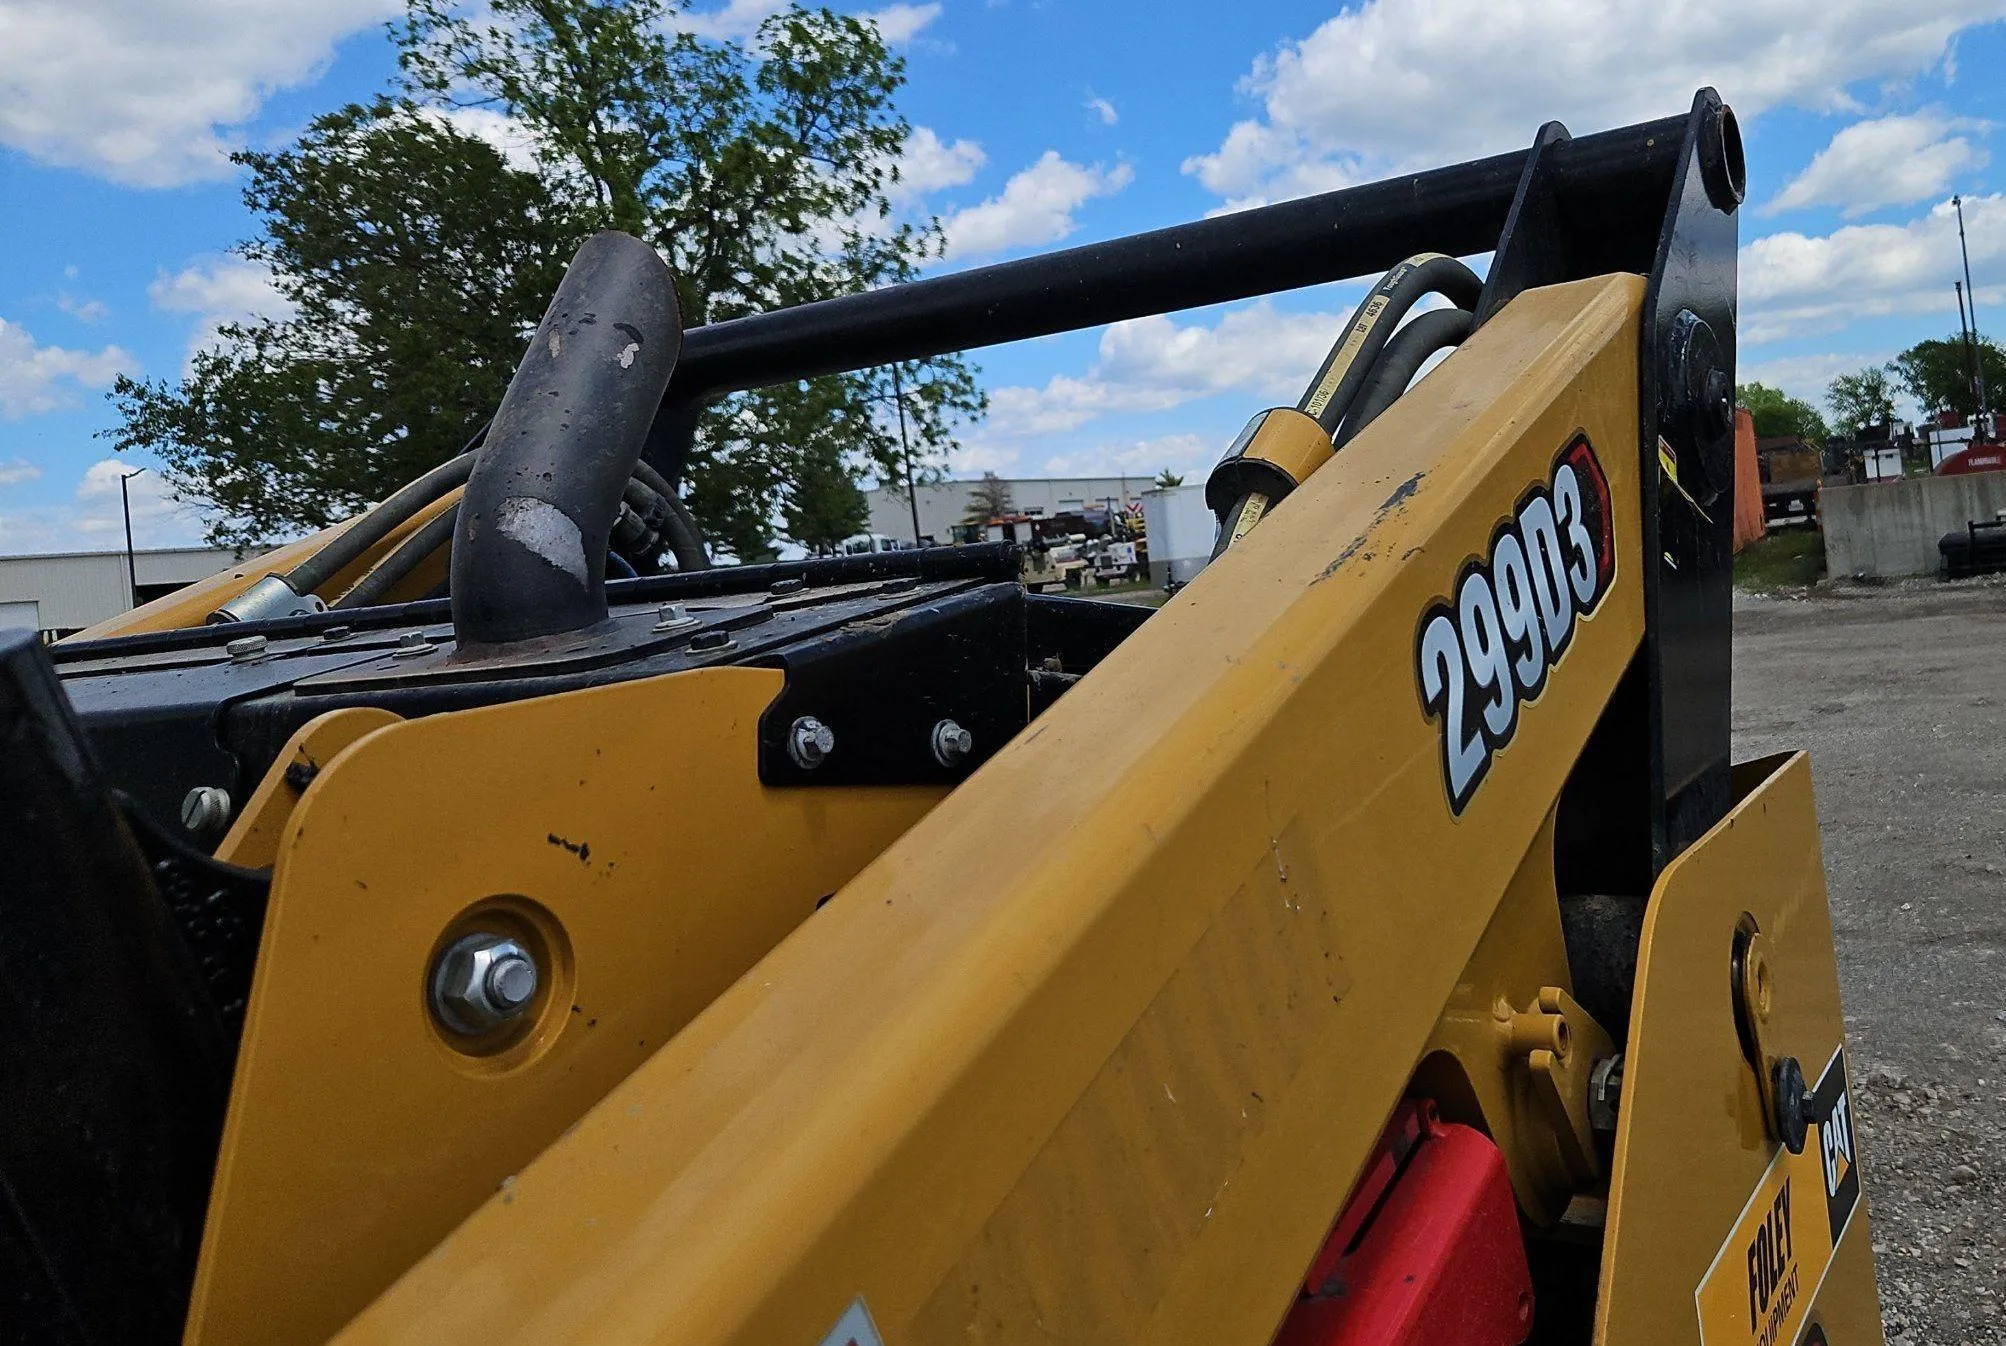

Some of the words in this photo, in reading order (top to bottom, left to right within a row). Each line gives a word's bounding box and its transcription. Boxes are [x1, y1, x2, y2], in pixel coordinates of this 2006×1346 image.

[1421, 464, 1597, 799] 299D3
[1823, 1091, 1850, 1197] CAT
[1747, 1175, 1792, 1335] FOLEY
[1756, 1262, 1799, 1346] QUIPMENT
